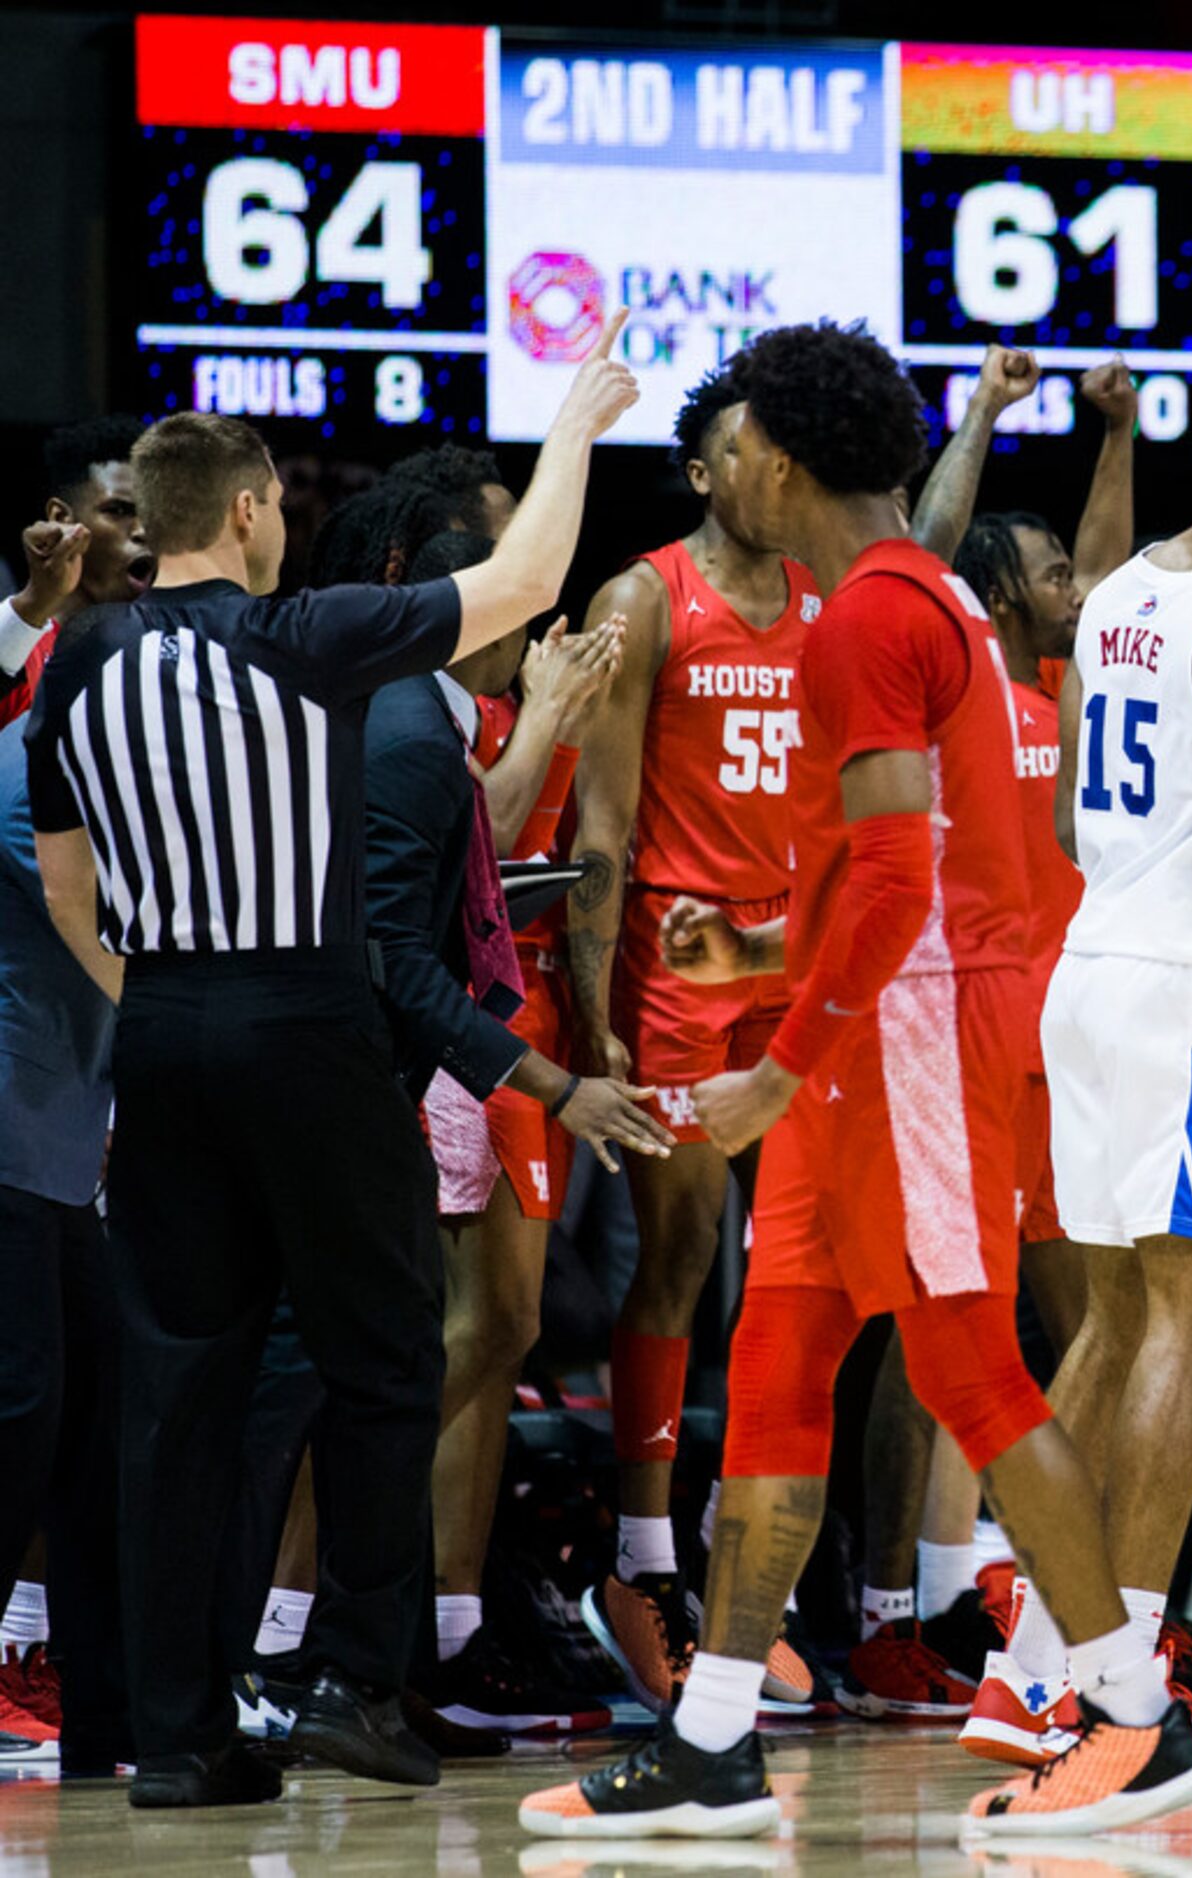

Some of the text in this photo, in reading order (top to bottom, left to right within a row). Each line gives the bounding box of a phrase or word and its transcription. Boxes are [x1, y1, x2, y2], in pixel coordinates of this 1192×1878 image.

[228, 42, 401, 110] SMU
[521, 56, 868, 154] 2ND HALF
[1010, 70, 1116, 134] UH
[202, 157, 432, 310] 64
[953, 181, 1158, 329] 61
[619, 264, 778, 315] BANK
[619, 321, 685, 368] OF
[193, 355, 423, 424] FOULS 8
[1099, 625, 1165, 675] MIKE
[1081, 691, 1160, 819] 15
